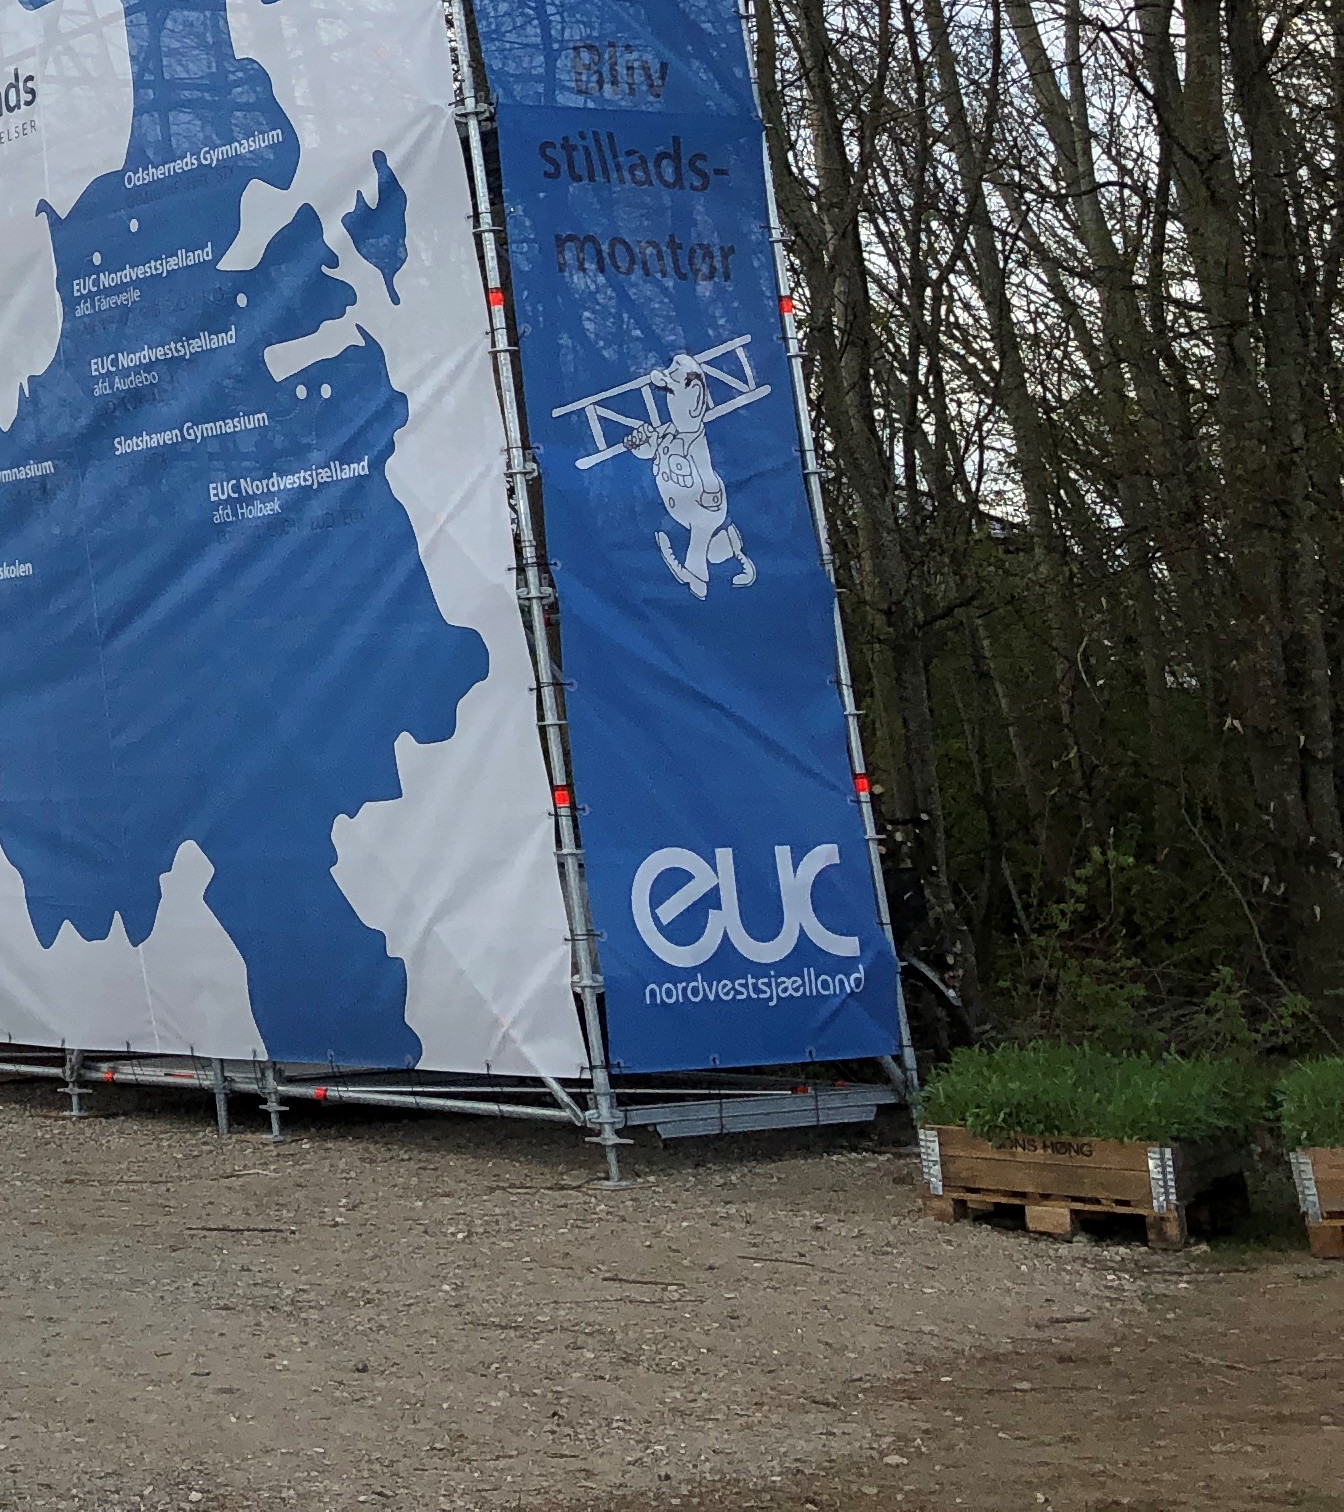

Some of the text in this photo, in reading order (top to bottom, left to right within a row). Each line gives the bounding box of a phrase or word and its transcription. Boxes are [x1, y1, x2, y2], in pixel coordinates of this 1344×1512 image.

[571, 40, 669, 99] Bliv
[124, 128, 283, 190] Odsherreds Gymnasium
[538, 129, 731, 193] stillads-
[72, 242, 213, 297] EUC Nordvestsjælland
[553, 231, 737, 284] montør
[74, 287, 141, 318] afd. Fårevejle
[90, 325, 237, 377] EUC Nordvestsjælland
[92, 369, 159, 397] afd. Audebo
[113, 411, 269, 456] Slotshaven Gymnasium
[208, 455, 370, 502] EUC Nordvestsjælland
[212, 497, 282, 524] afd. Holbæk
[630, 842, 861, 968] euc
[644, 962, 866, 1007] nordvestsjælland
